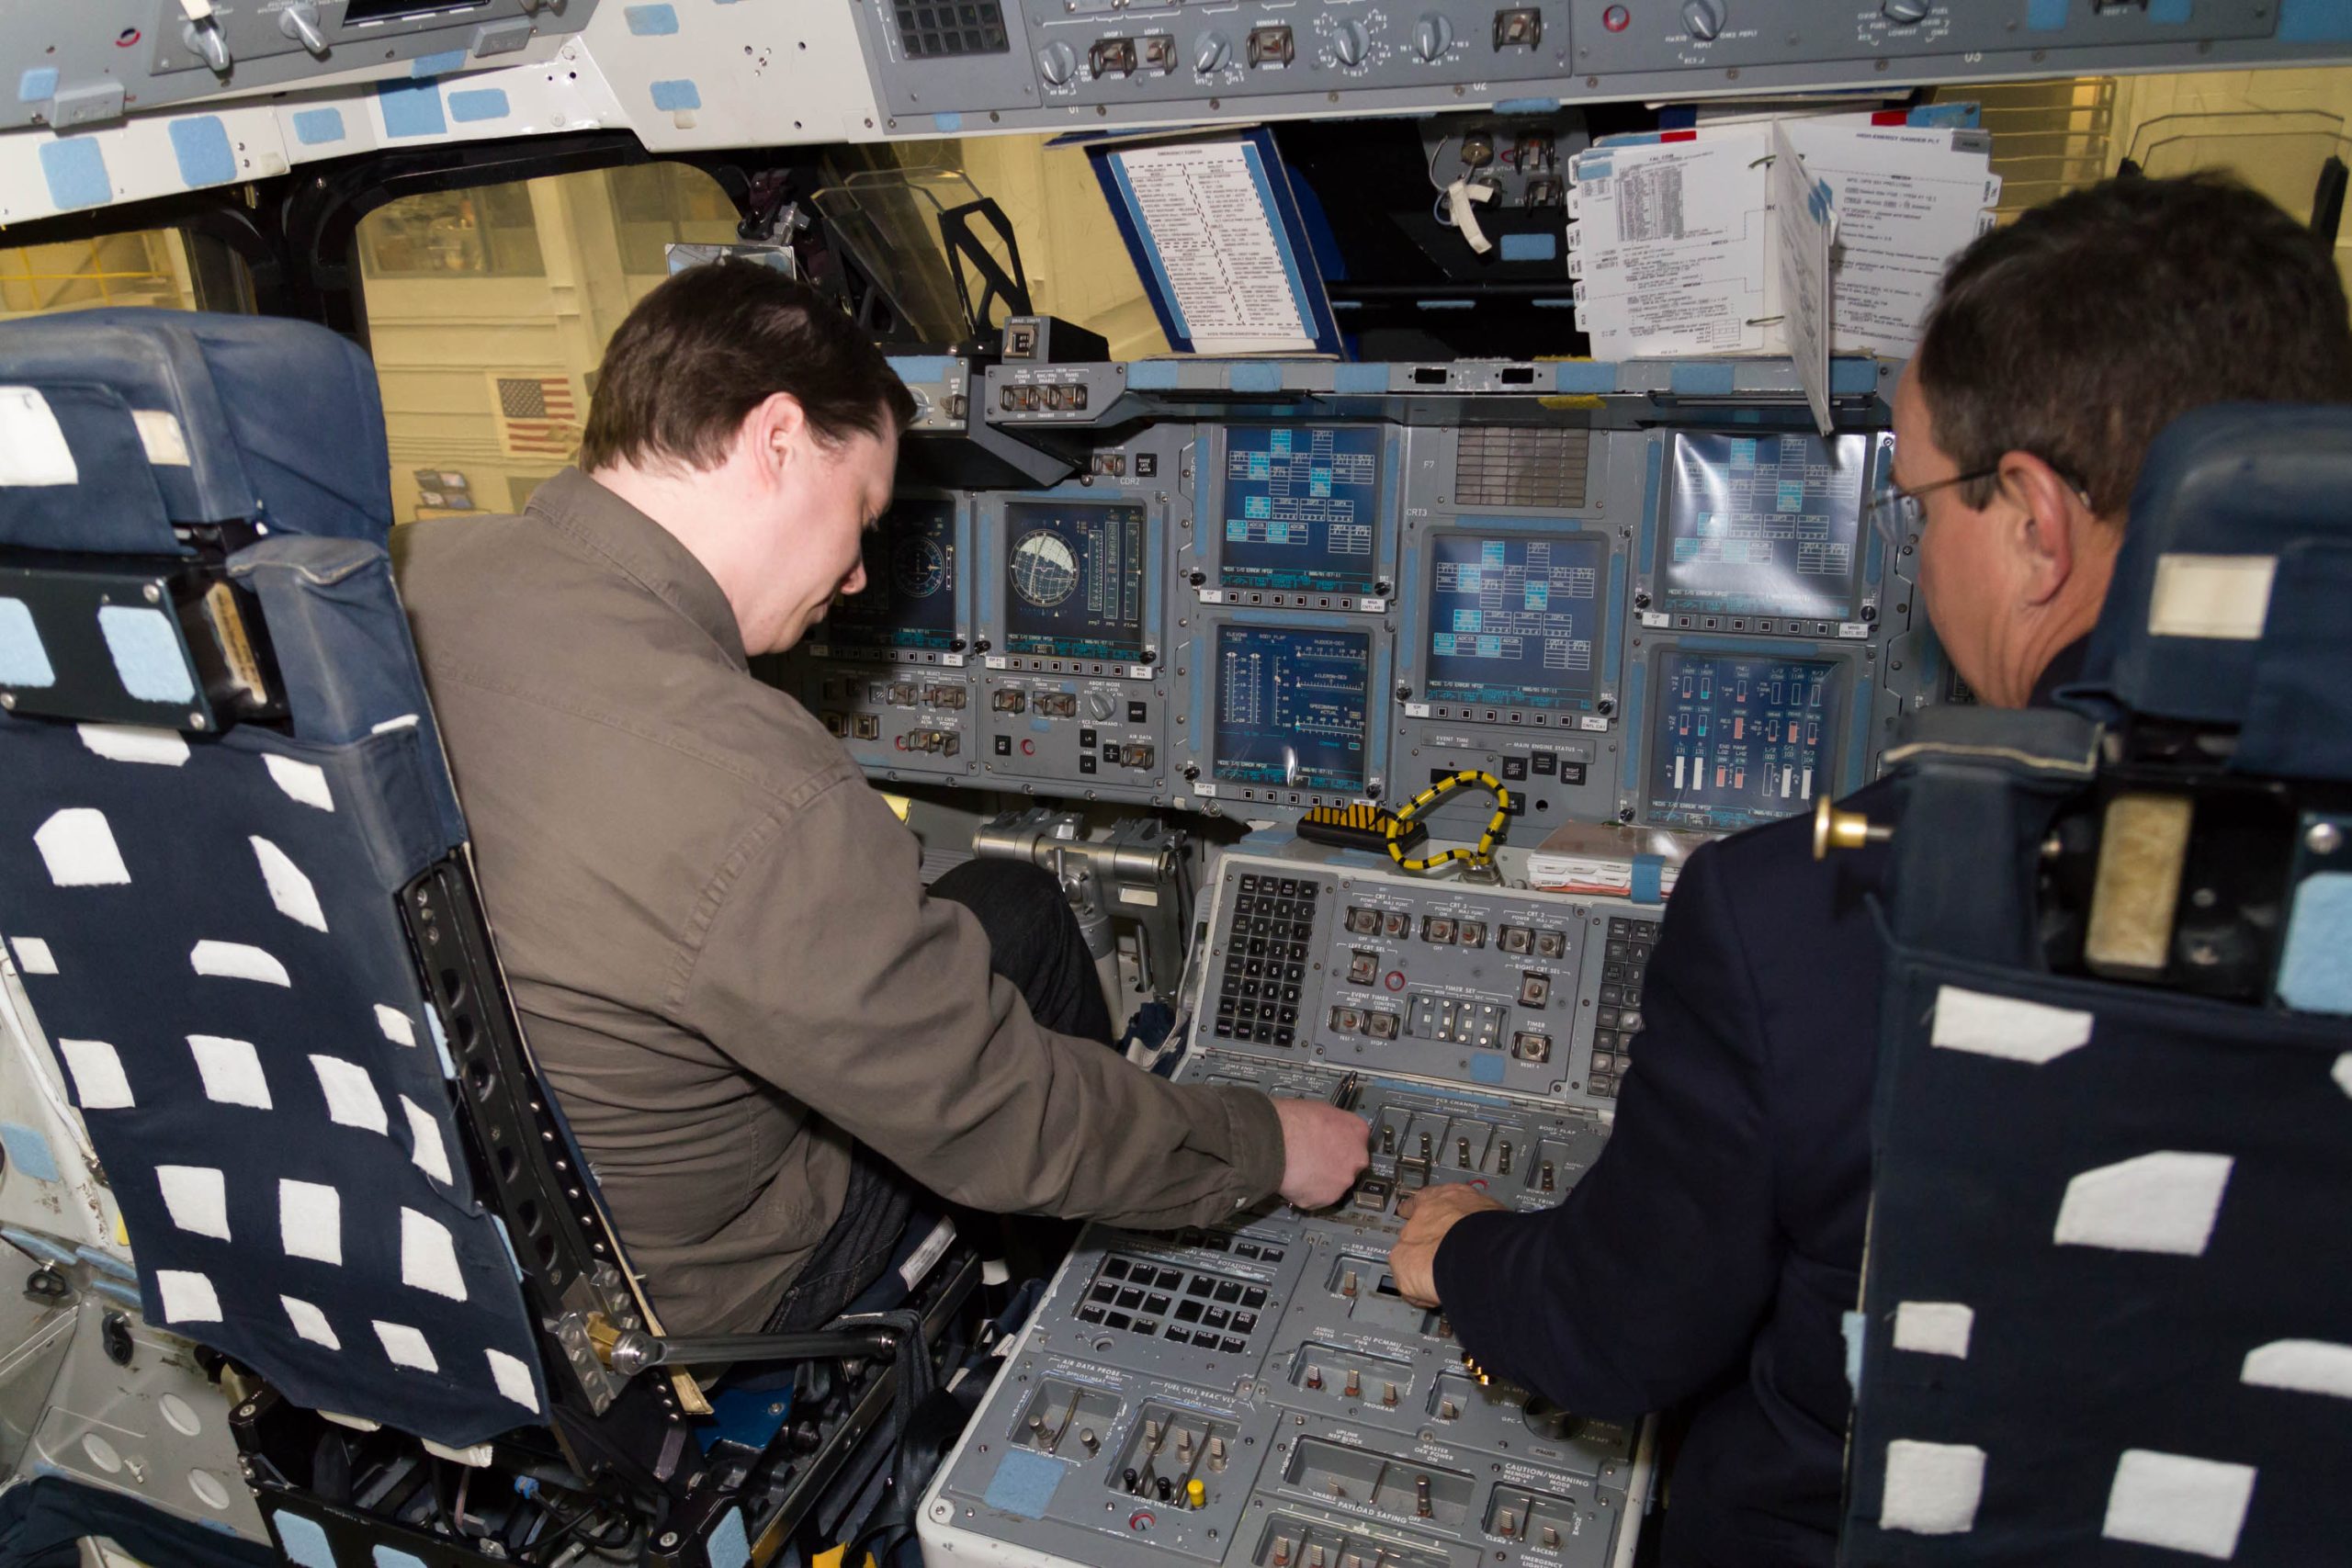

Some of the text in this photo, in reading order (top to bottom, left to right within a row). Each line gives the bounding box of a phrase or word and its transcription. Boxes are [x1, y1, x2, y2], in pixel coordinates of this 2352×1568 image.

[1424, 460, 1434, 468] F7
[1406, 508, 1428, 516] CRT3
[1275, 946, 1281, 954] 2
[1295, 949, 1301, 957] 3
[1251, 964, 1257, 973] 4
[1272, 966, 1277, 976] 5
[1515, 964, 1533, 972] RIGHT
[1292, 969, 1297, 978] 6
[1249, 985, 1254, 993] 7
[1449, 1100, 1479, 1109] CHANNEL
[1516, 1194, 1555, 1206] PITCH TRIM
[1200, 1252, 1220, 1260] MODE
[1217, 1259, 1252, 1271] ROTATION
[1084, 1305, 1100, 1314] PULSE
[1170, 1325, 1187, 1335] PULSE
[1197, 1331, 1214, 1339] PULSE
[1076, 1362, 1095, 1371] DATA
[1096, 1368, 1121, 1377] PROBE
[1163, 1382, 1237, 1404] FUEL CELL REAC VLV
[1363, 1402, 1396, 1413] PROGRAM
[1335, 1428, 1359, 1438] UPLINK
[1341, 1436, 1363, 1445] BLOCK
[1422, 1444, 1449, 1453] MASTER
[1414, 1447, 1453, 1461] OEX POWER
[1505, 1462, 1589, 1487] CAUTION/WARNING
[1505, 1470, 1535, 1481] MEMORY
[1549, 1480, 1570, 1489] MODE
[1312, 1491, 1337, 1502] ENABLE
[1338, 1501, 1408, 1524] PAYLOAD SAFING
[1531, 1545, 1558, 1557] ASCENT
[1521, 1554, 1563, 1568] EMERGENCY
